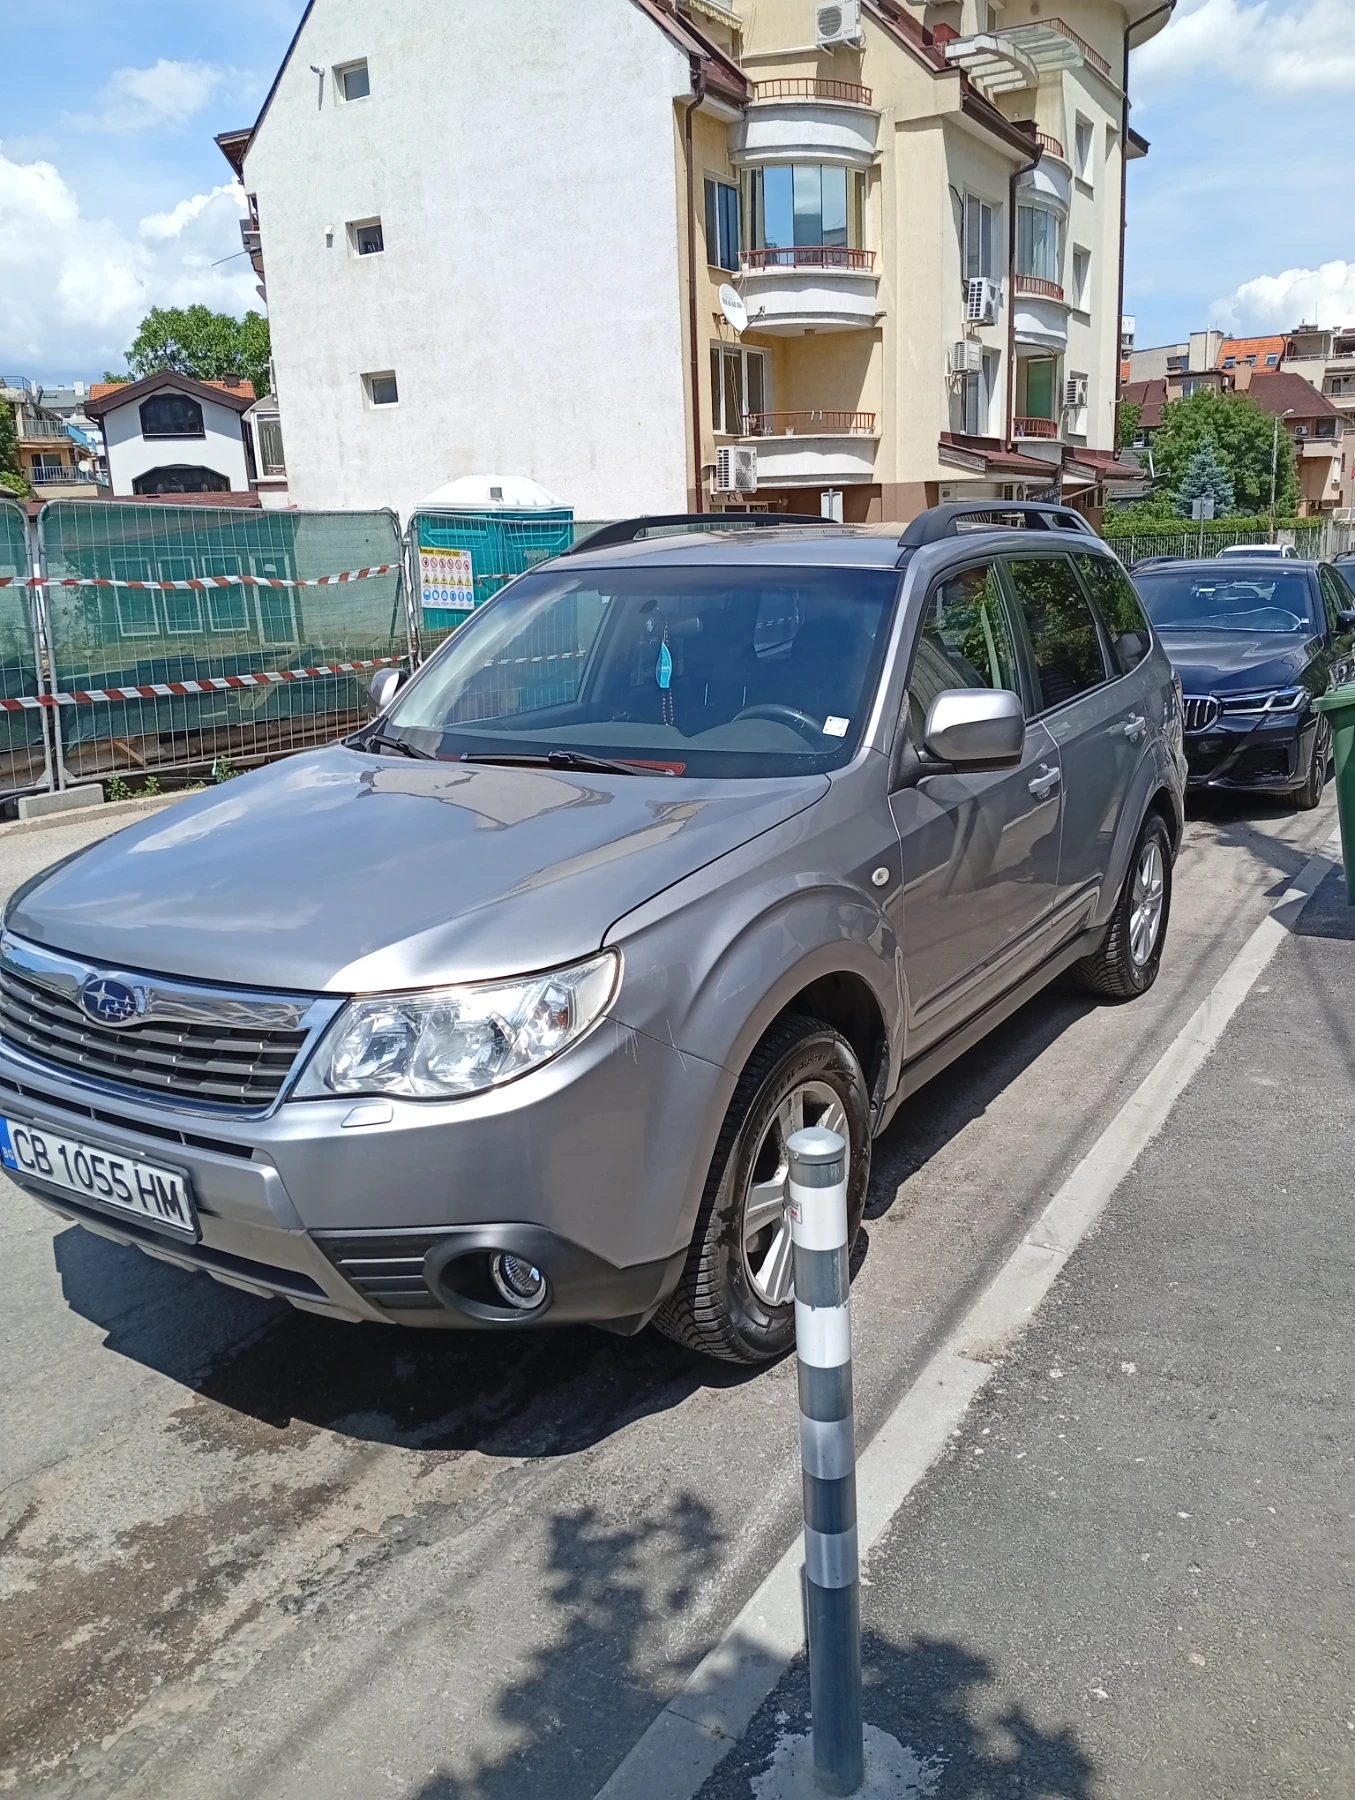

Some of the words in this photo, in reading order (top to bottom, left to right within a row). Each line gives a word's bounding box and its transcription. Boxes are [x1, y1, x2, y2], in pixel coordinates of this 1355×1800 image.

[3, 1147, 15, 1160] BG
[13, 1129, 54, 1176] CB
[58, 1144, 133, 1203] 1055
[134, 1168, 186, 1223] HM
